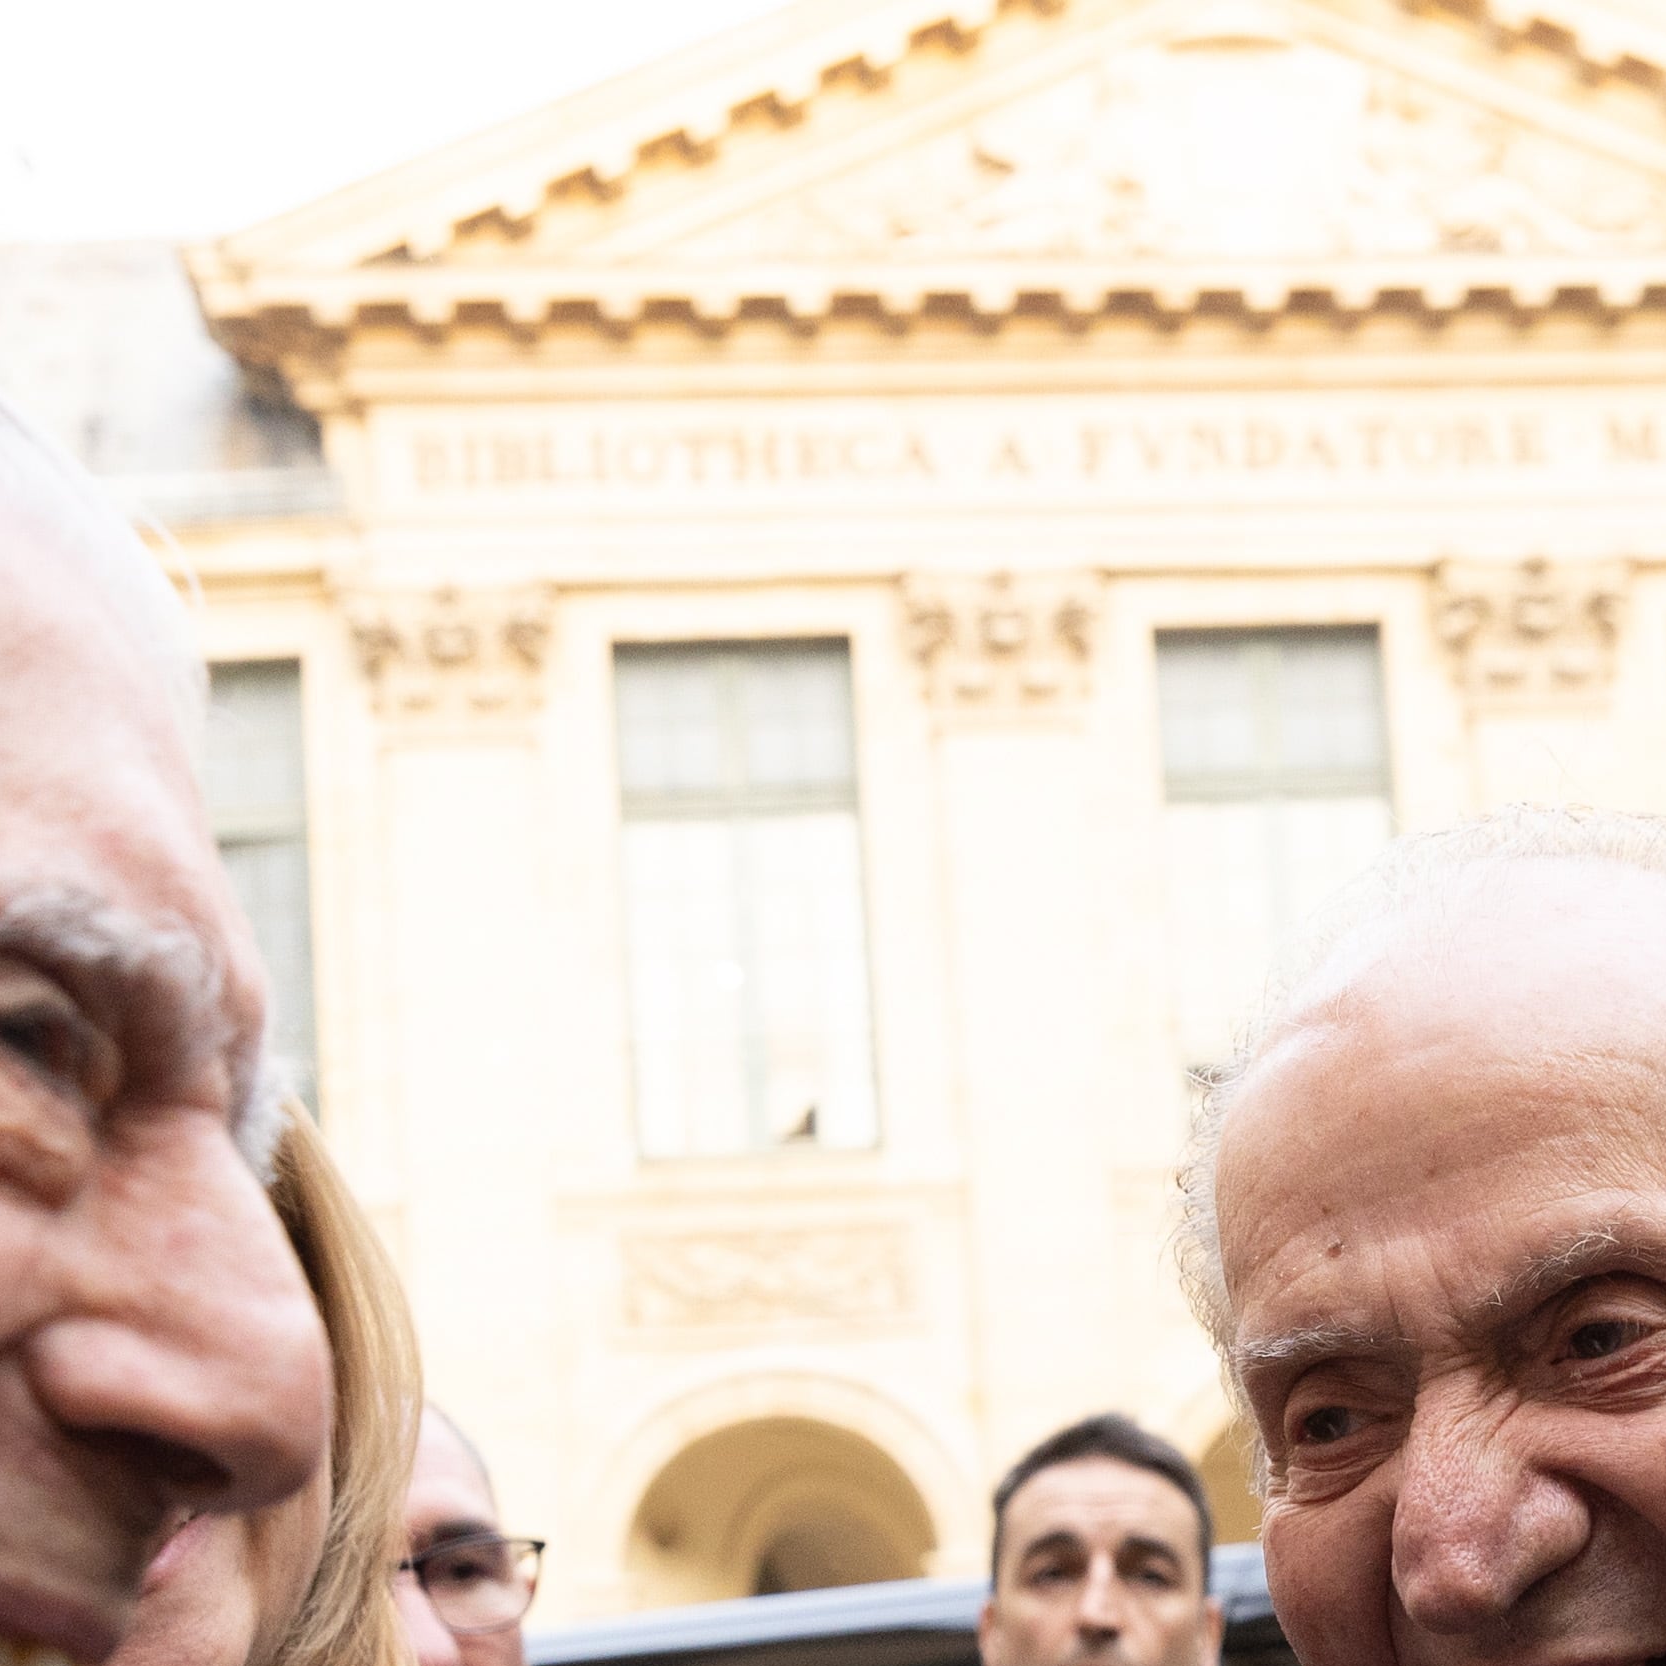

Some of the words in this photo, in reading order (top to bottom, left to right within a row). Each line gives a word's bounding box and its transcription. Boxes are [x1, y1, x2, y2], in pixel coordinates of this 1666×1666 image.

[410, 427, 937, 490] BIBLIOTHECA
[985, 432, 1035, 479] A
[1075, 419, 1548, 477] FVNDATORE
